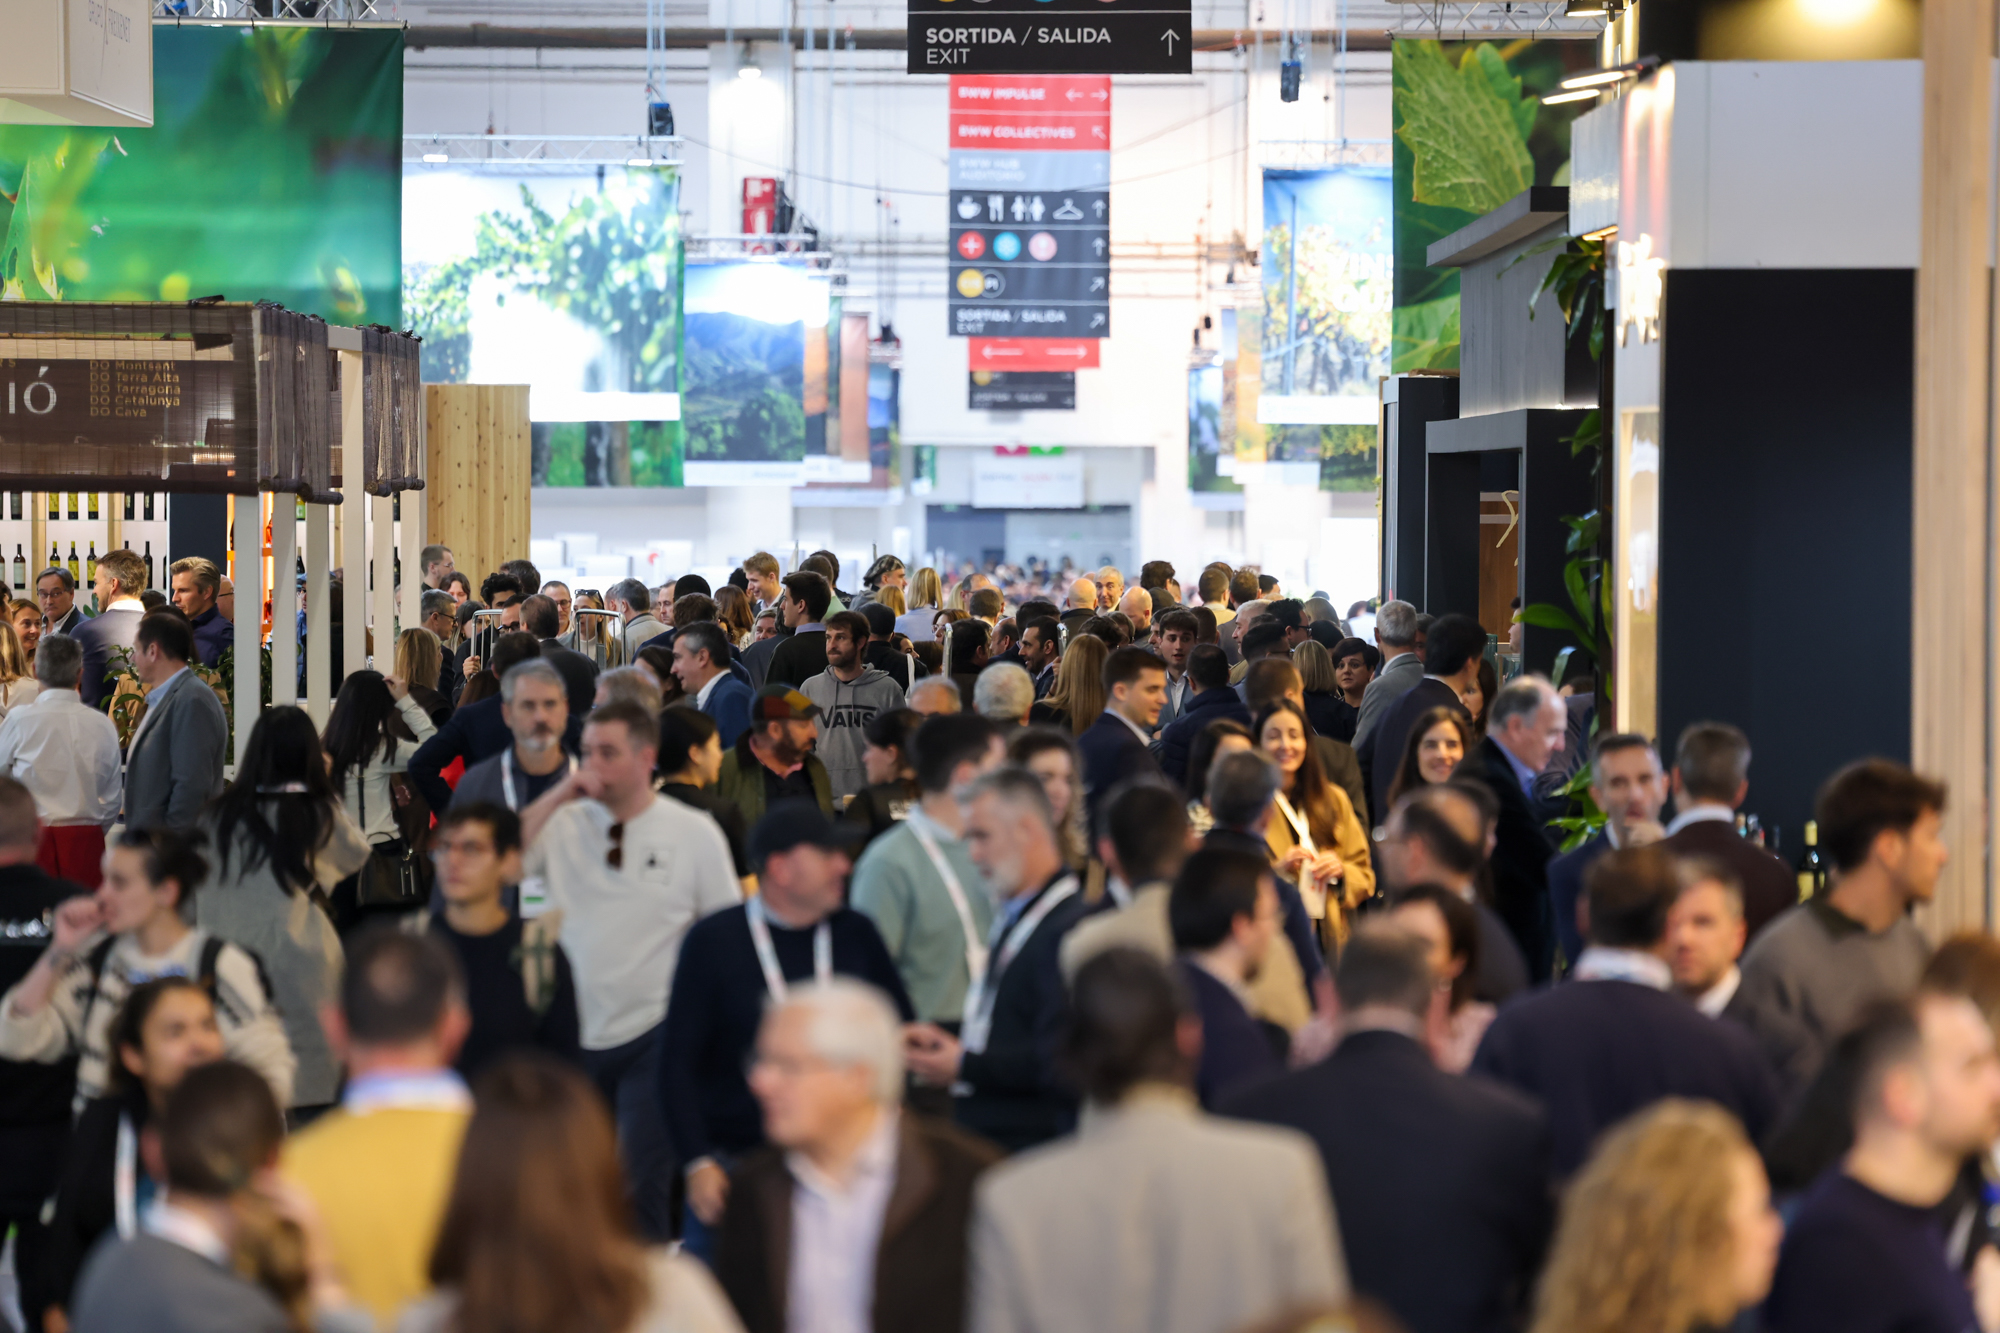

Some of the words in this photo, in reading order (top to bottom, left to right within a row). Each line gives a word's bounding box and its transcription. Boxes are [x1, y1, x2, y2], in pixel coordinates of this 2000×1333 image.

[926, 27, 1017, 44] SORTIDA
[1037, 27, 1112, 44] SALIDA
[926, 48, 971, 64] EXIT
[958, 86, 992, 99] BWW
[993, 87, 1046, 100] IMPULSE
[958, 124, 992, 138] BWW
[993, 125, 1076, 139] COLLECTIVES
[956, 308, 1012, 322] SORTIDA
[1021, 309, 1067, 323] SALIDA
[956, 323, 985, 333] EXIT
[90, 361, 110, 370] DO
[115, 361, 176, 370] Montsant
[90, 372, 110, 382] DO
[116, 372, 148, 383] Terra
[152, 372, 179, 383] Alta
[90, 384, 110, 393] DO
[116, 383, 181, 395] Tarragona
[90, 395, 110, 405] DO
[115, 395, 180, 408] Catalunya
[90, 407, 110, 416] DO
[115, 407, 147, 417] Cava
